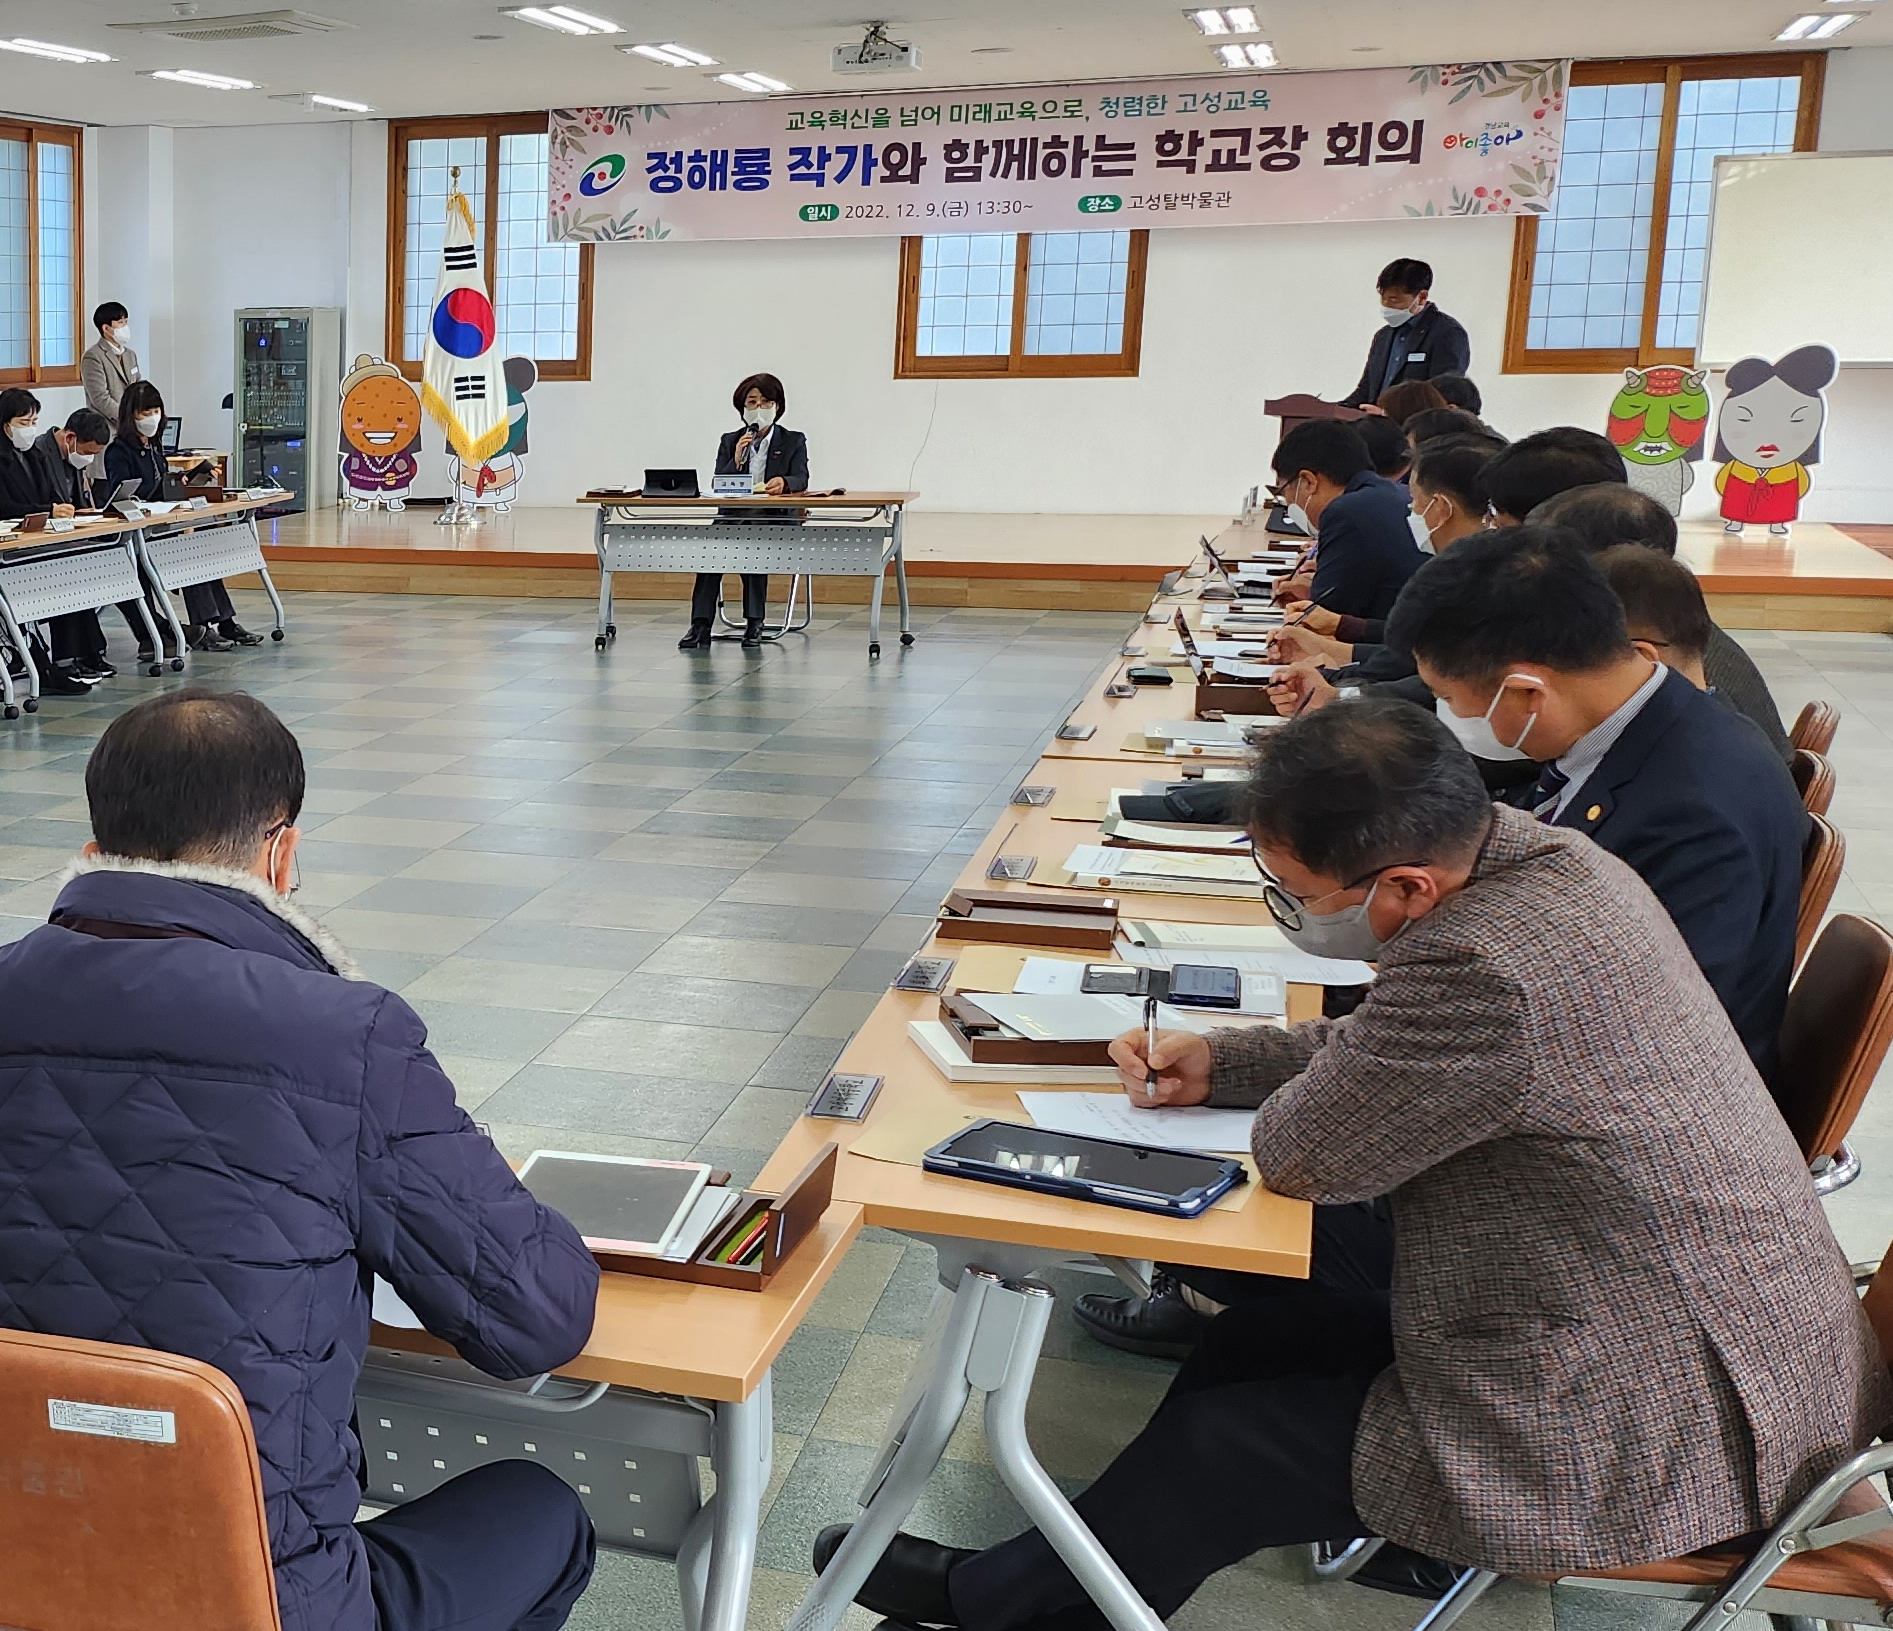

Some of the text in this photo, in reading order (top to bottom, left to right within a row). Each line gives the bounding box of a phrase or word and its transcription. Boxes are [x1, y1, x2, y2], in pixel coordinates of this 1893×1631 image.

[785, 89, 1272, 131] 교육혁신을 넘어 미래교육으로, 청렴한 고성교육
[644, 118, 1425, 194] 정해룡 작가와 함께하는 학교장 회의
[805, 199, 1034, 221] 일시 2022. 12. 9.(금) 13:30~
[1086, 191, 1232, 212] 장소 고성탈박물관
